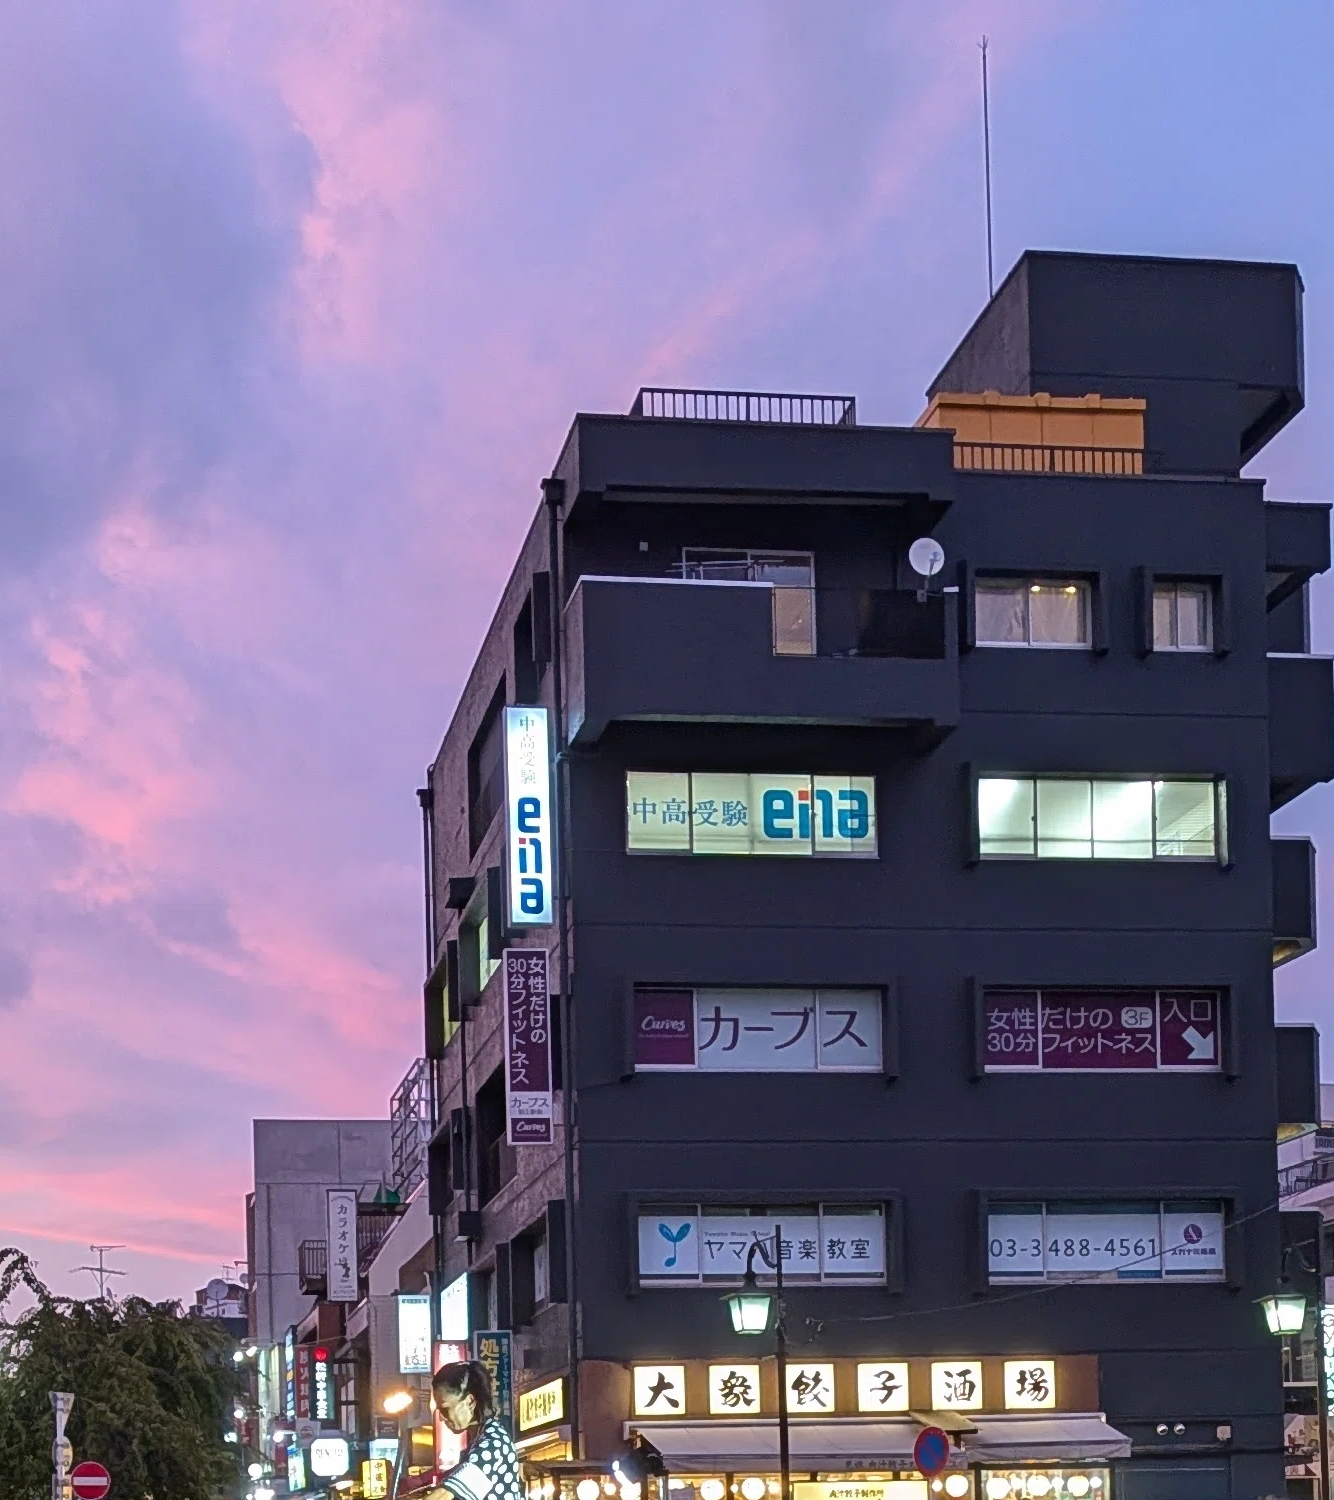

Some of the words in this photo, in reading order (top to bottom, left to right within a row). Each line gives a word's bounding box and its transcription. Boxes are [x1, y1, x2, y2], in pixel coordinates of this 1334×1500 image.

[518, 714, 537, 785] 中高受験
[632, 796, 748, 827] 中高受験
[763, 788, 869, 839] ena
[517, 796, 545, 915] ena
[507, 958, 530, 1085] 30分フィットネス
[527, 956, 547, 1044] 女性だけの
[986, 1007, 1113, 1030] 女性だけの
[1123, 1009, 1150, 1026] 3F
[1163, 998, 1212, 1023] 入口
[640, 1015, 686, 1031] Curves
[698, 1006, 868, 1051] カーブス
[986, 1033, 1155, 1054] 30分フィットネス
[516, 1121, 546, 1132] Curves
[336, 1203, 351, 1256] カラオケ
[989, 1238, 1157, 1257] 03-3488-4561
[646, 1367, 1050, 1409] 大衆餃子酒場
